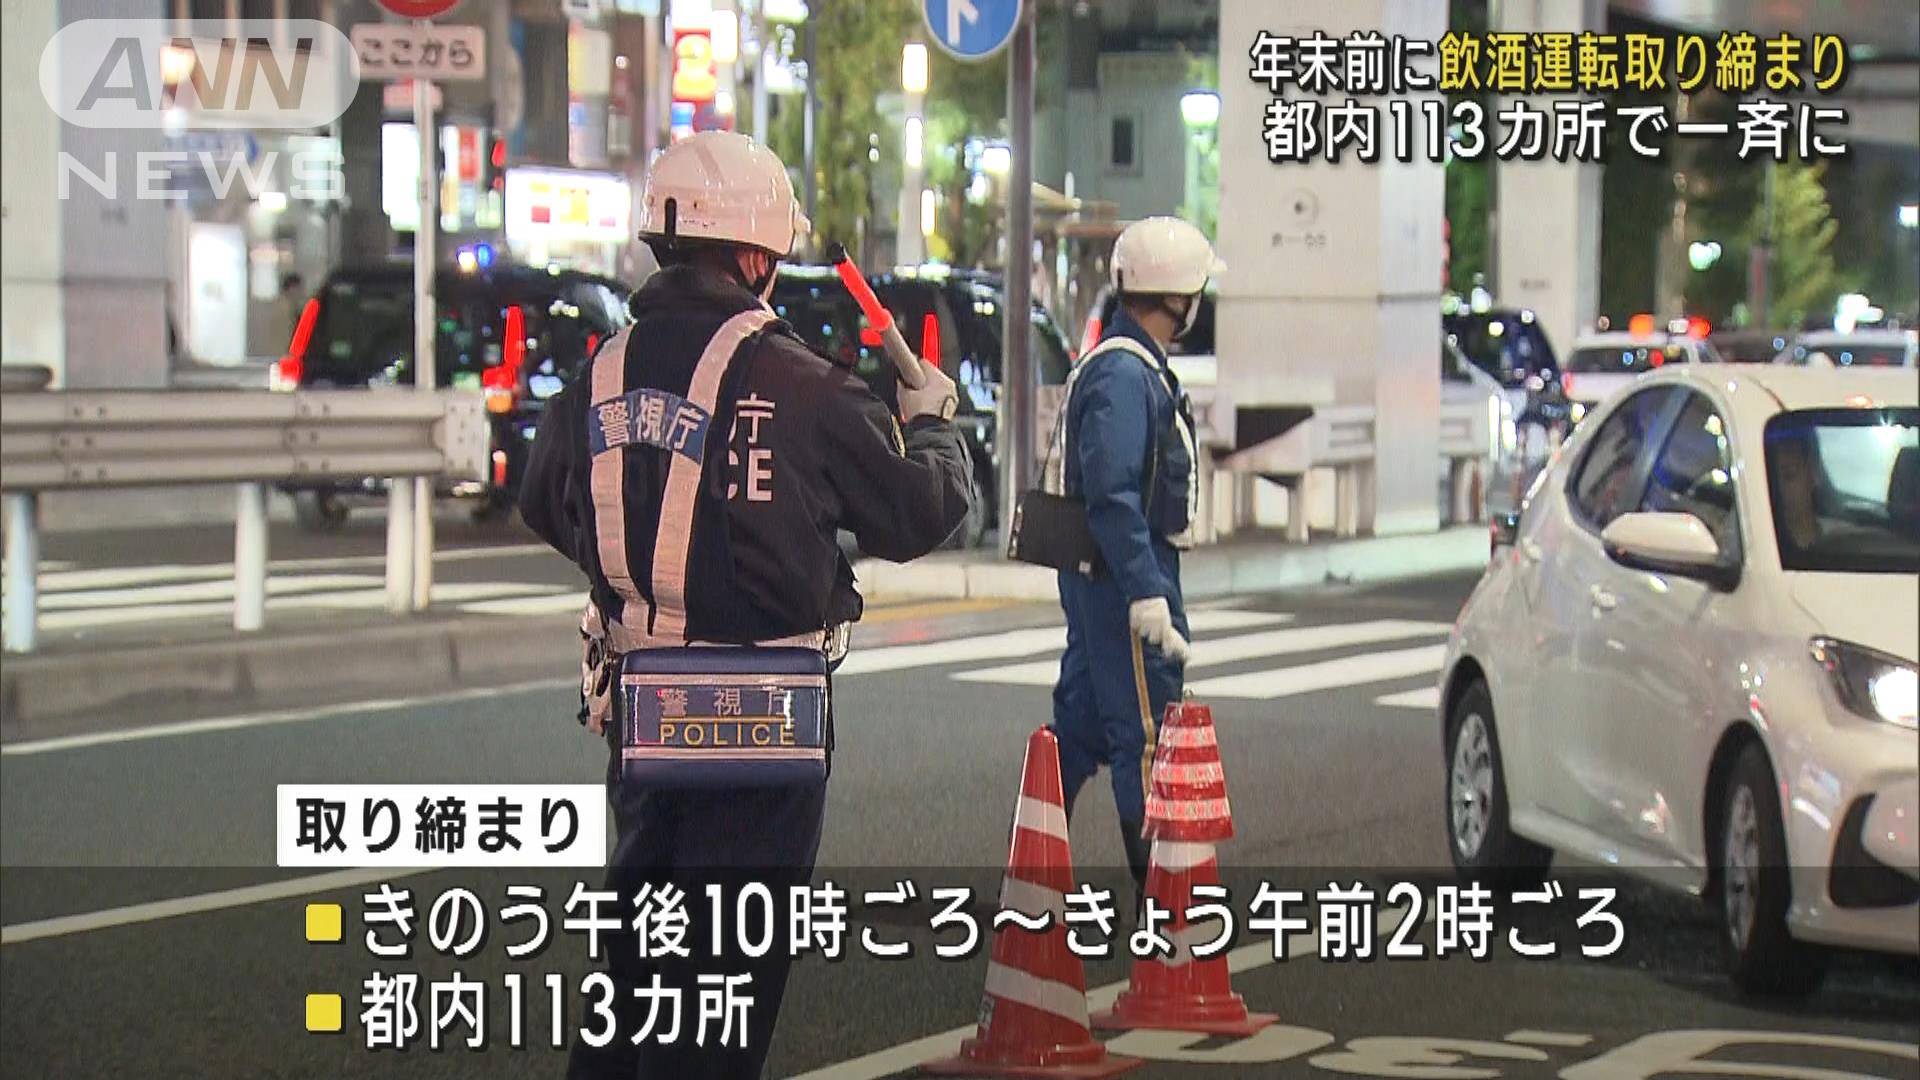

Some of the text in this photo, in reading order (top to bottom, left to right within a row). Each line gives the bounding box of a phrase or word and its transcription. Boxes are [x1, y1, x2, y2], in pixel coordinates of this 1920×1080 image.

[361, 38, 475, 68] ここから
[597, 392, 703, 450] 警視庁
[660, 686, 794, 718] 警視庁
[659, 723, 796, 746] POLICE
